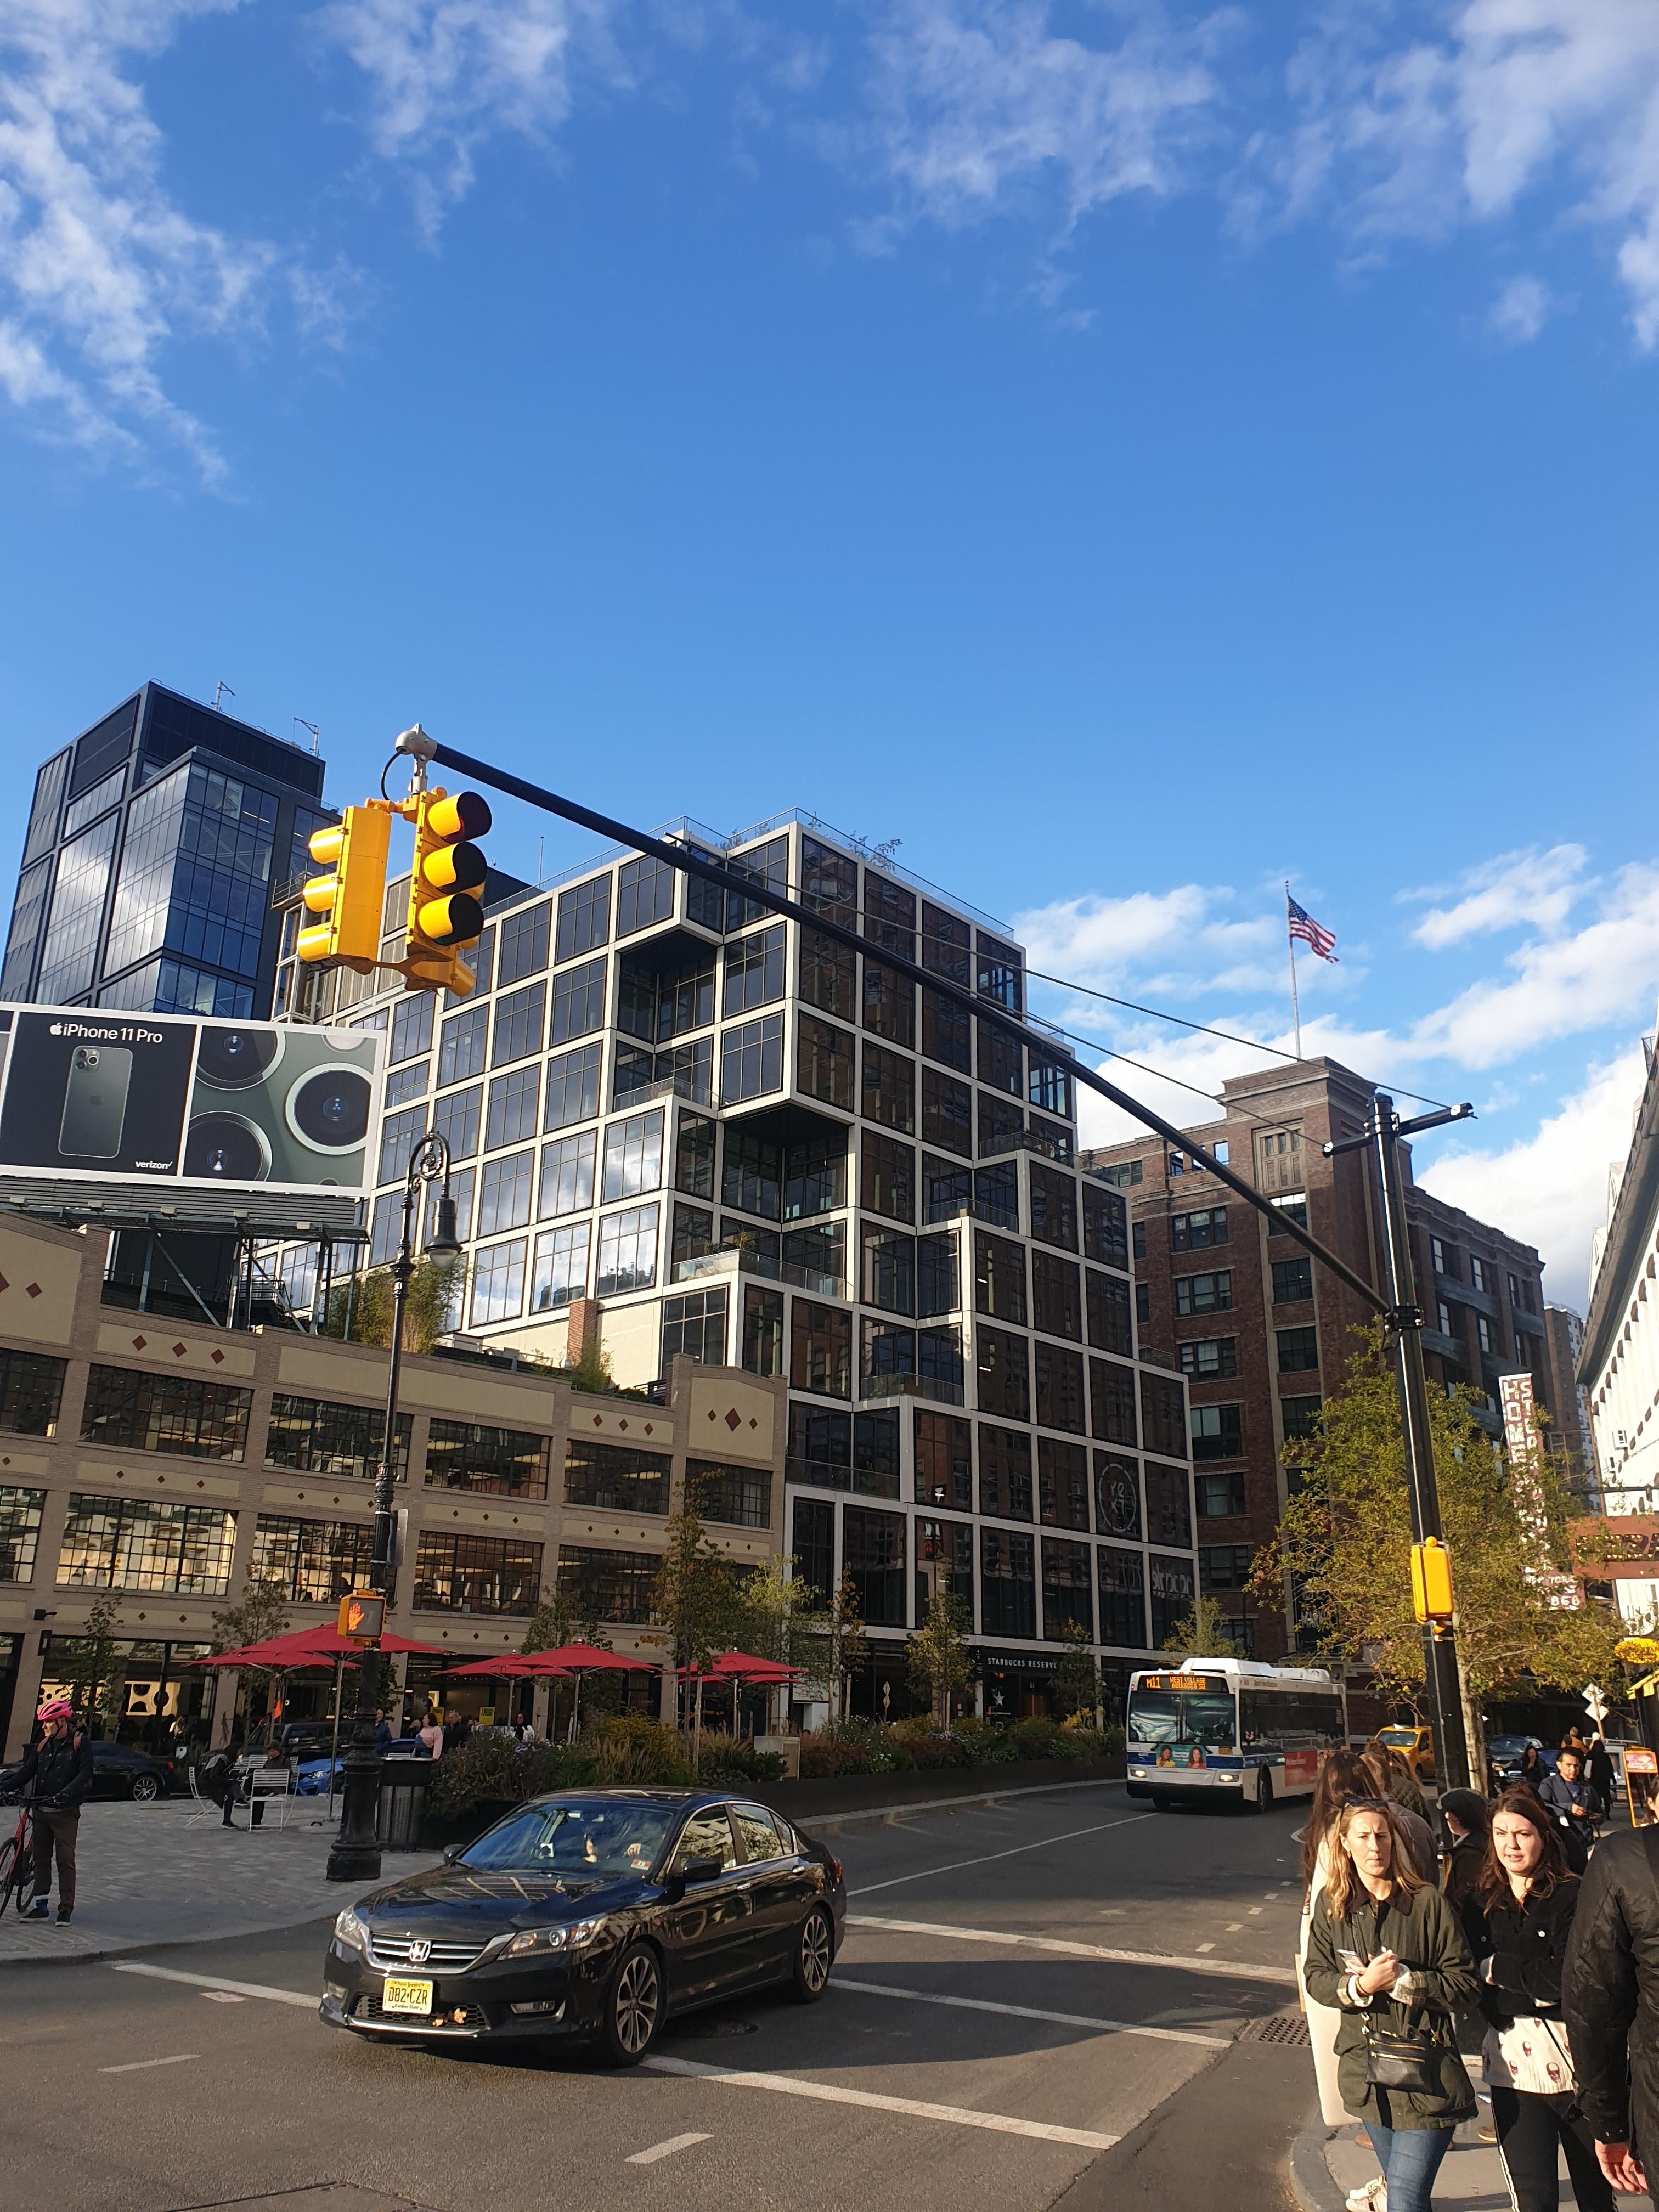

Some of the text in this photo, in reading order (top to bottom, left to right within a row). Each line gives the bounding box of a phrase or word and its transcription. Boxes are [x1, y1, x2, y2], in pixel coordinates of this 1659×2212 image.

[63, 1023, 163, 1043] iPhone 11 Pro
[135, 1160, 169, 1169] verizon
[988, 1657, 1025, 1667] STARBUCKS
[1028, 1660, 1057, 1669] RESERVE
[1146, 1676, 1161, 1688] M11
